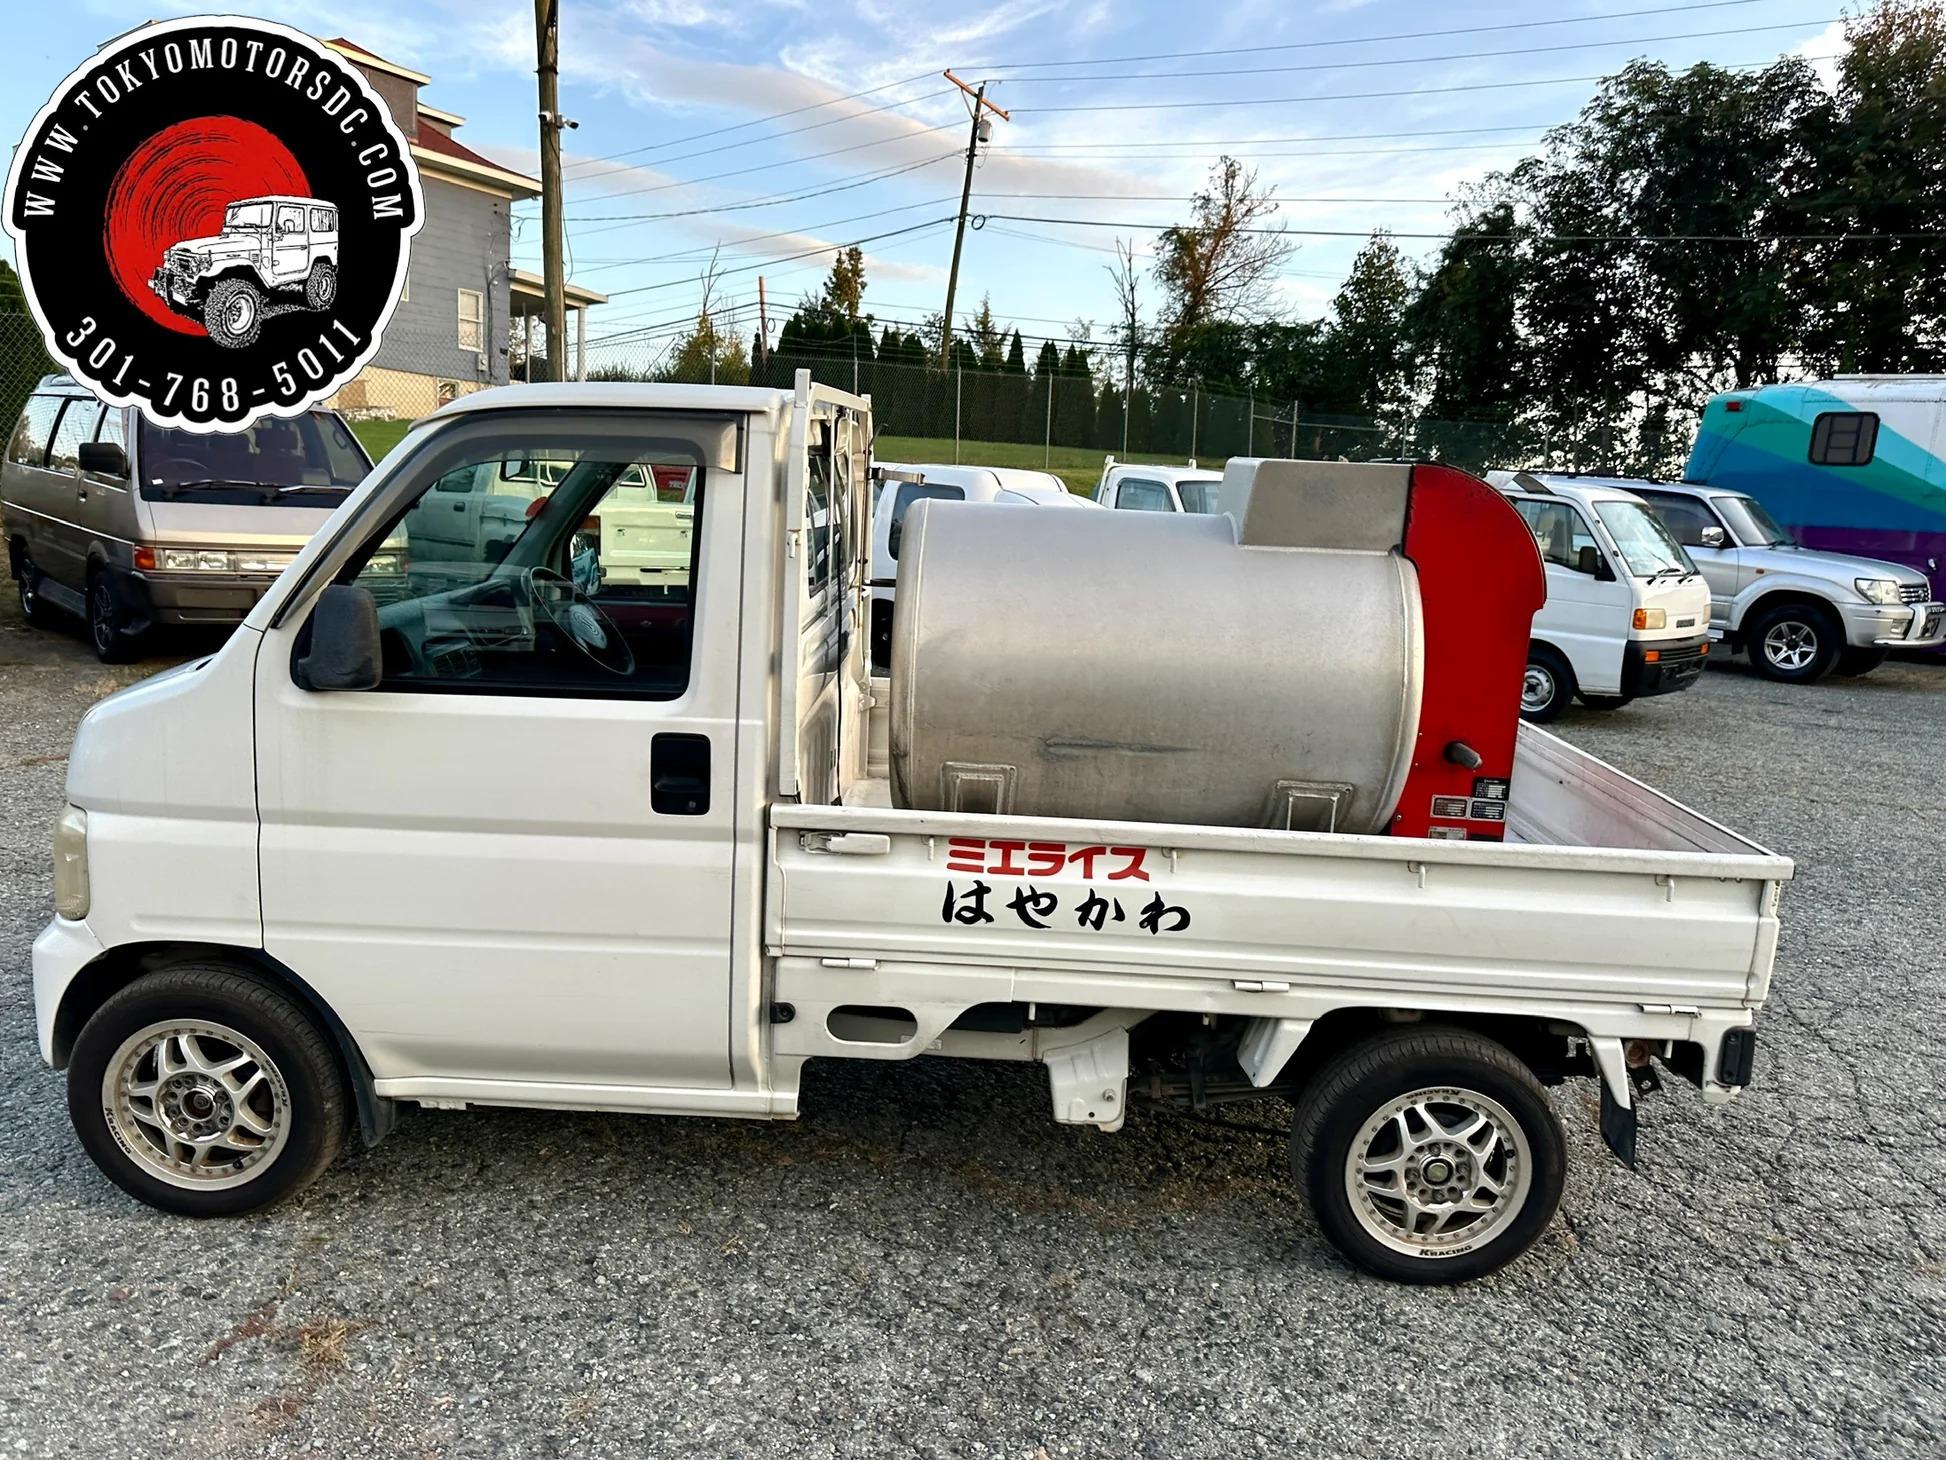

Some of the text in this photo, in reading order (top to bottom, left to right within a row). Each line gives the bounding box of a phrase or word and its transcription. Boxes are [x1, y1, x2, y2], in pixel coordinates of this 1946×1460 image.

[946, 837, 1150, 882] ミエライス
[942, 879, 1192, 935] はやかわ
